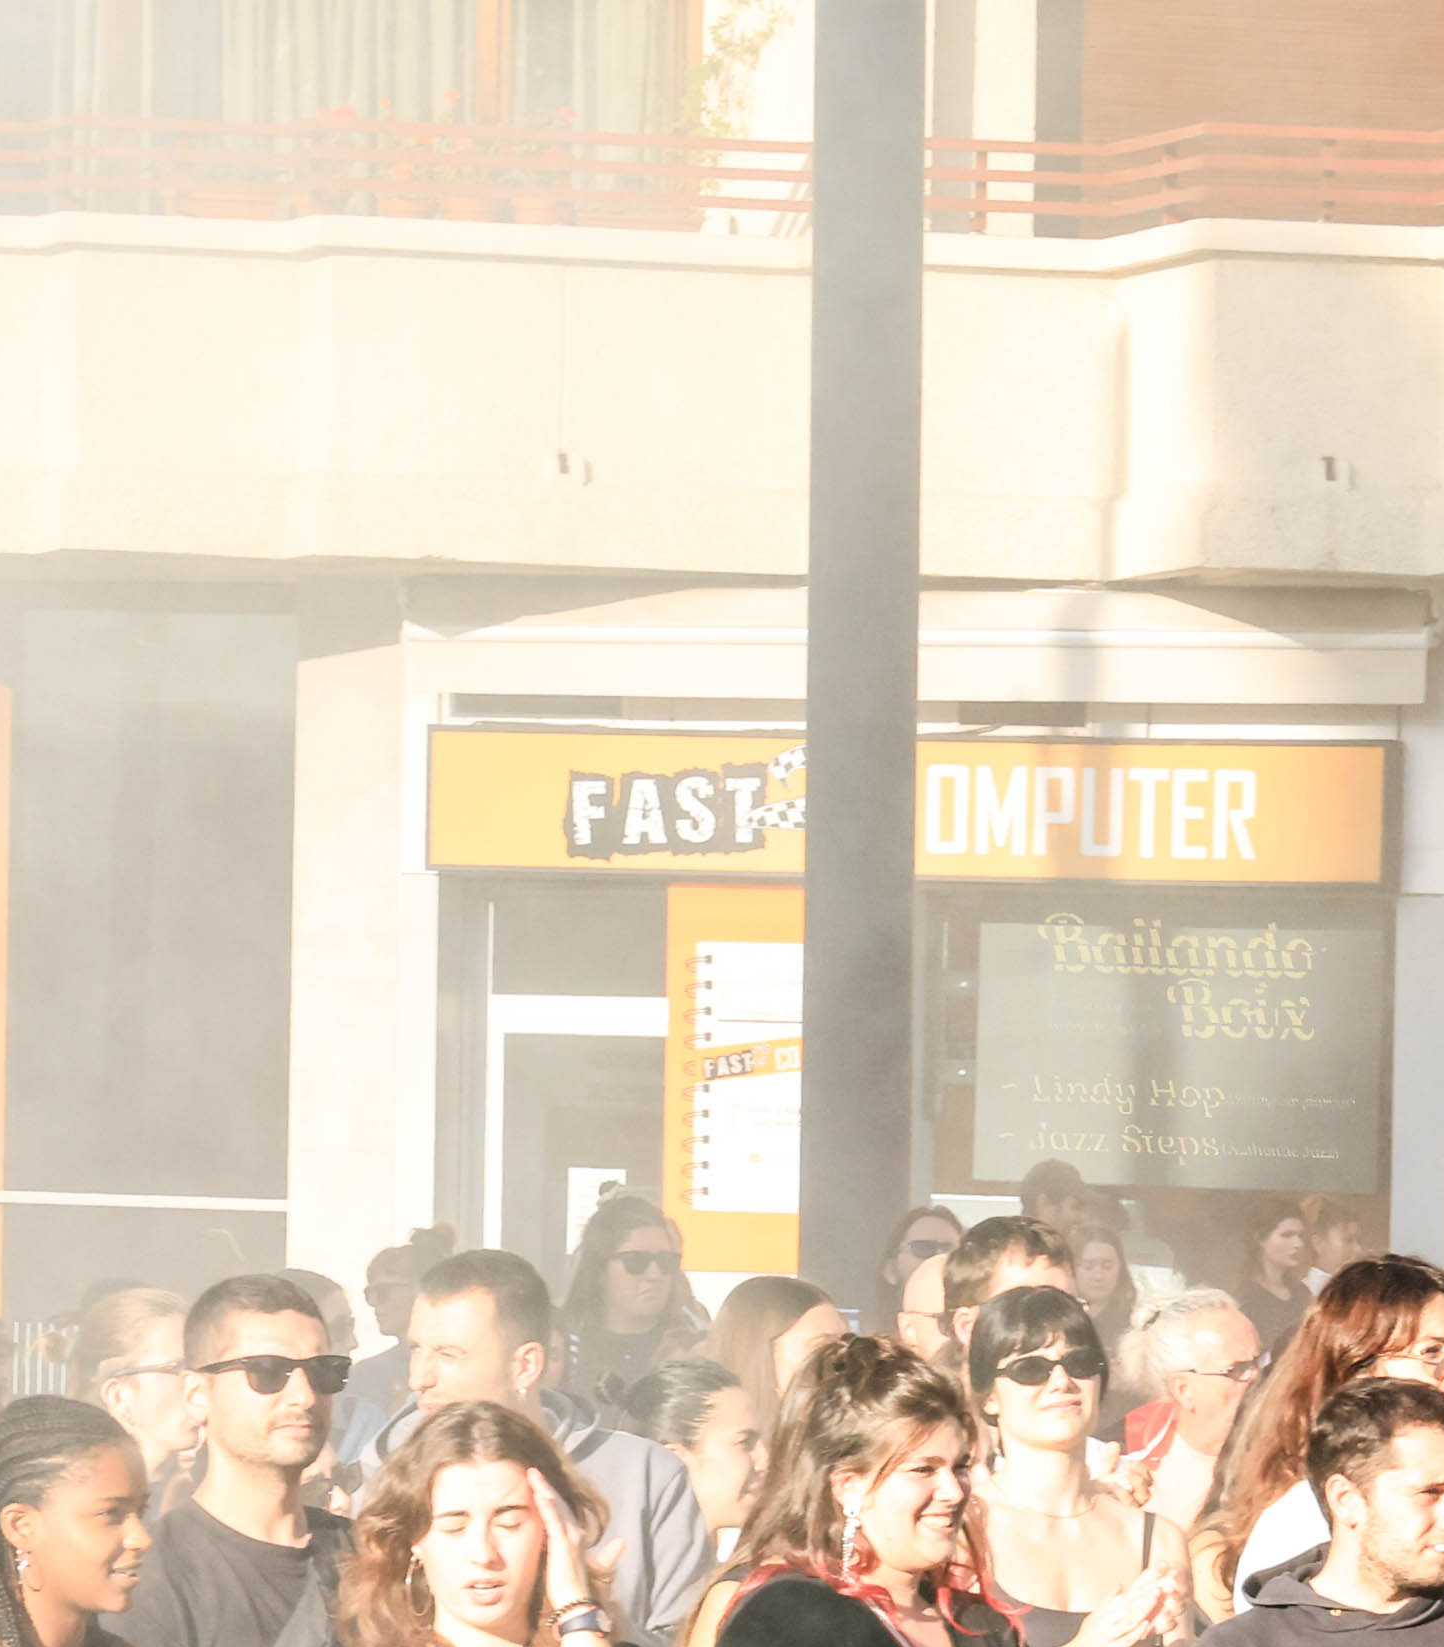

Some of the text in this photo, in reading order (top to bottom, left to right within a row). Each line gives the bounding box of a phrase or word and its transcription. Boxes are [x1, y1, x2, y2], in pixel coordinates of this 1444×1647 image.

[570, 763, 1257, 861] FAST OMPUTER
[1149, 1078, 1227, 1119] Hop
